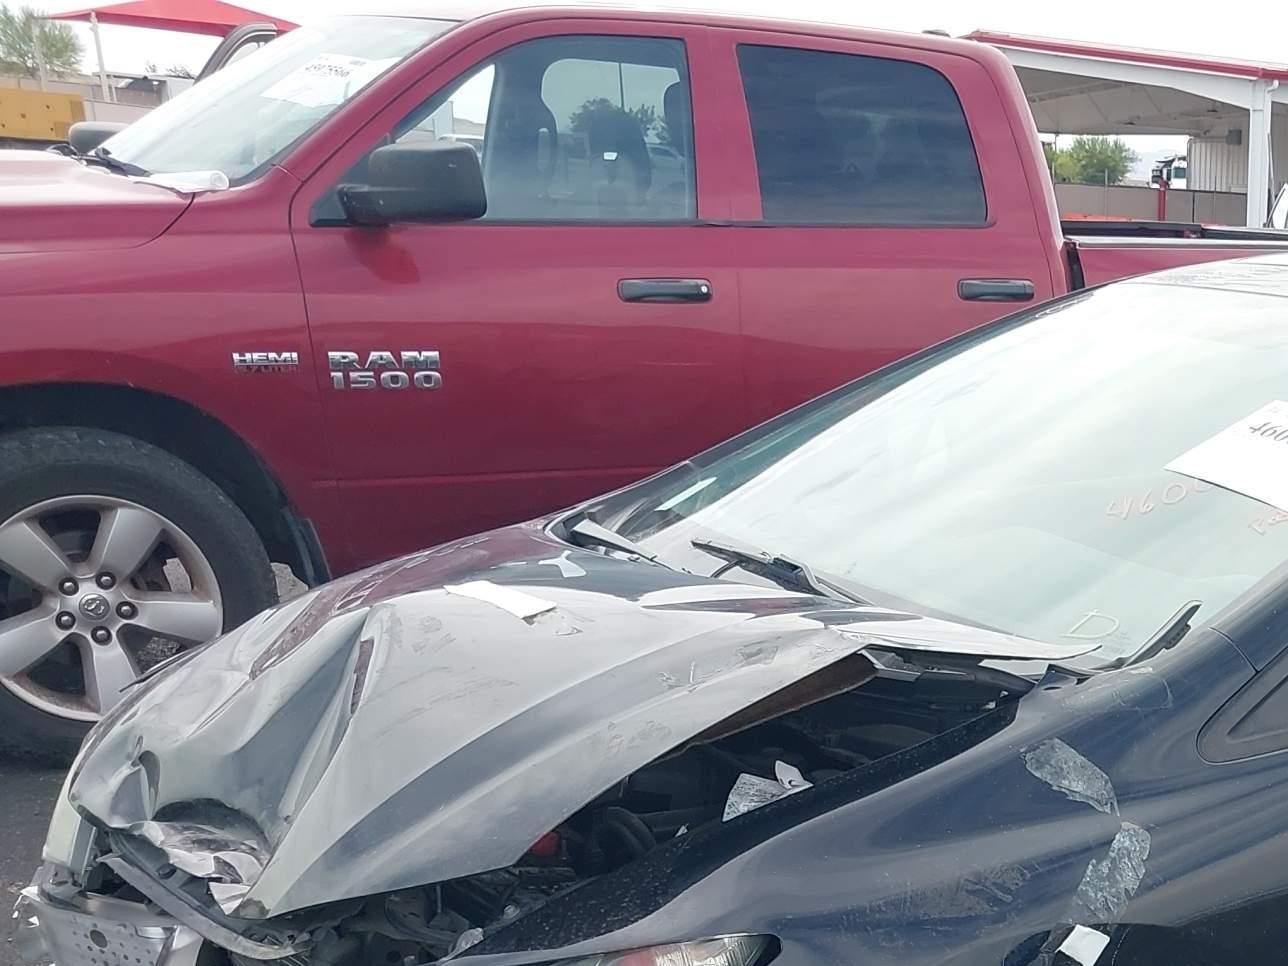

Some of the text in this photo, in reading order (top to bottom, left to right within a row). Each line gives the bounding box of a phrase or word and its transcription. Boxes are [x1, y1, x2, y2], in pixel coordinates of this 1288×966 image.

[232, 352, 298, 366] HEMI
[328, 351, 440, 369] RAM
[330, 371, 443, 390] 1500
